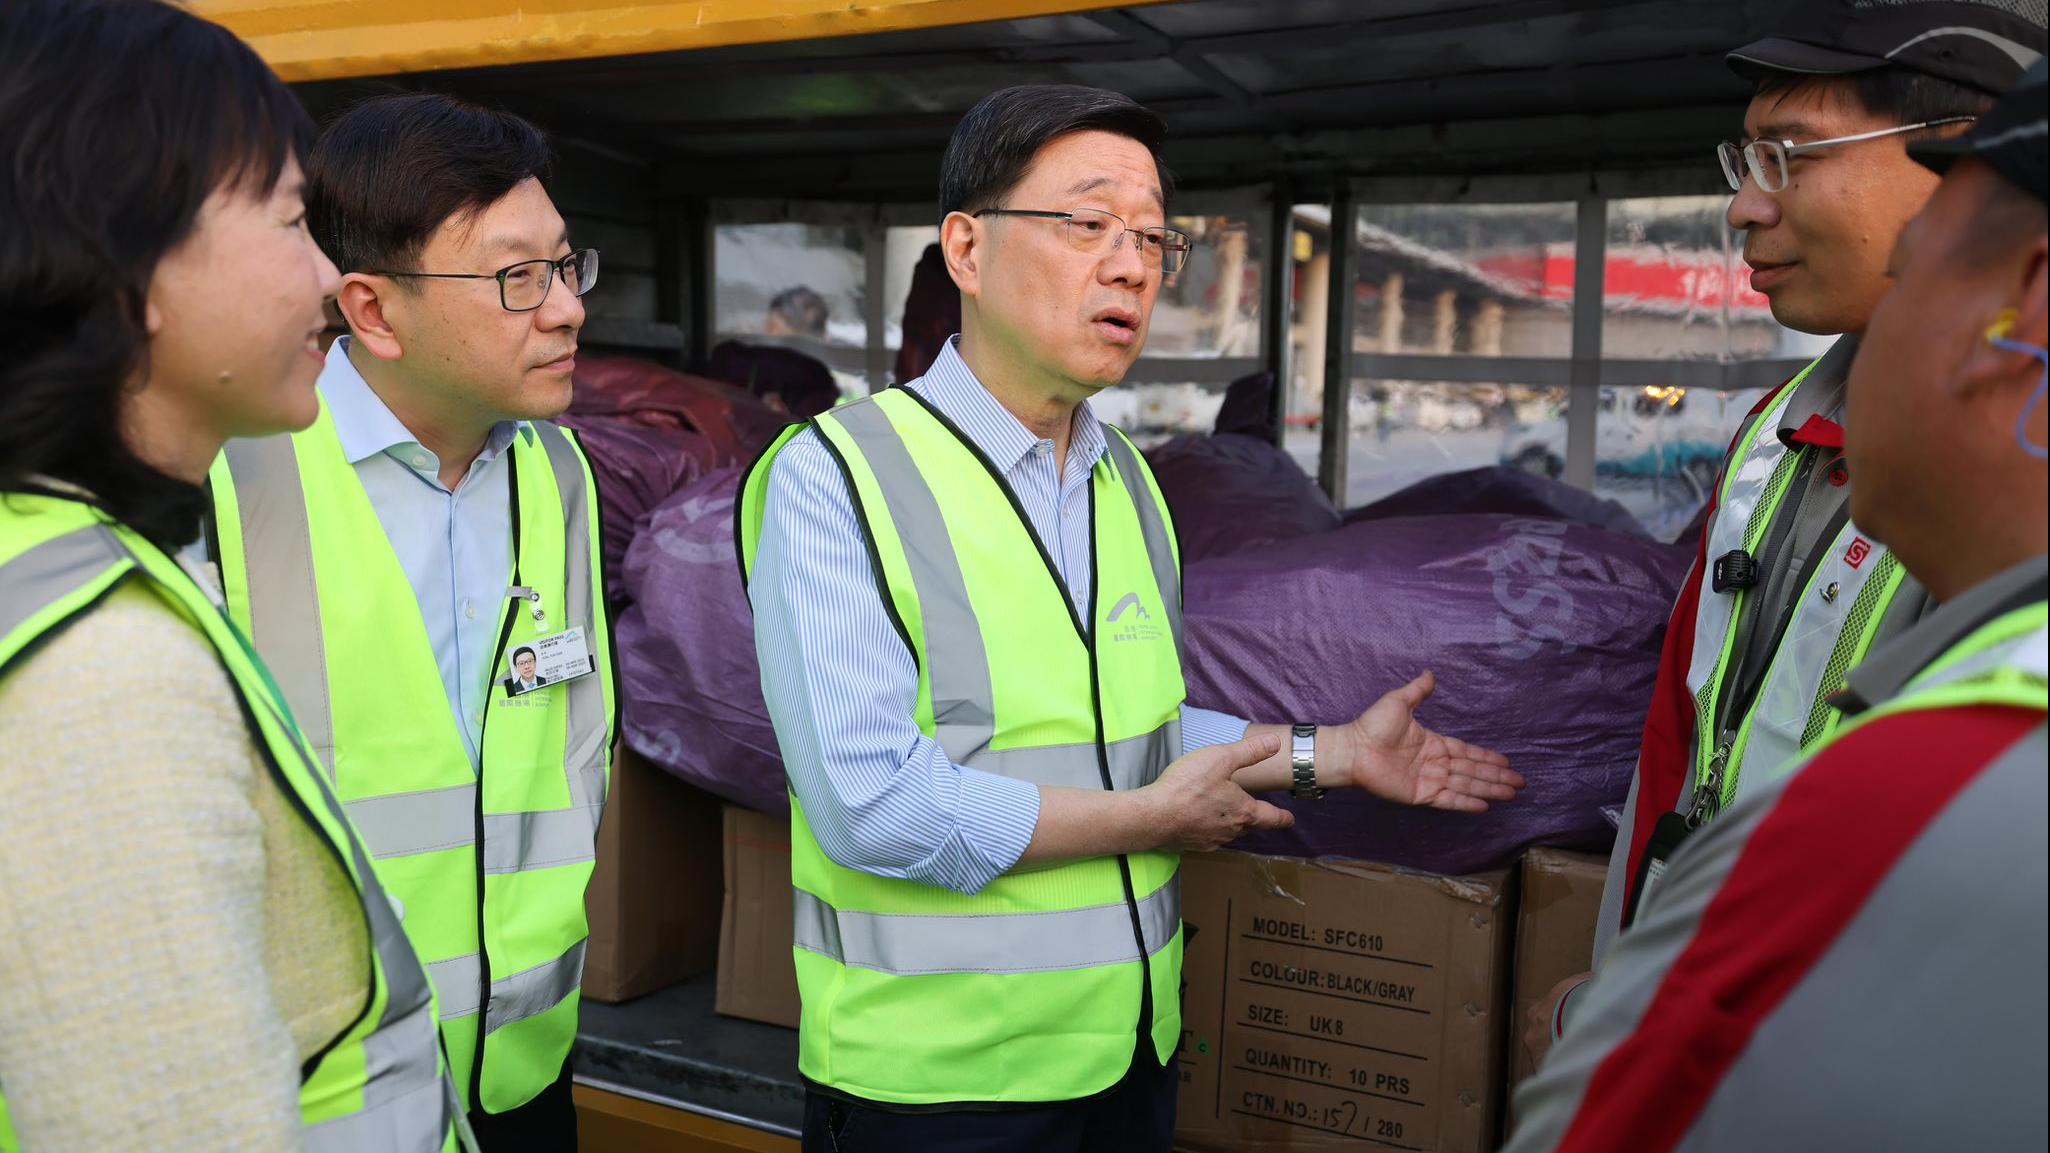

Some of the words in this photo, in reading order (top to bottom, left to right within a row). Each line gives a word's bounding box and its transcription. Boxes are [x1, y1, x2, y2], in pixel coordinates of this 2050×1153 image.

[1253, 917, 1316, 941] MODEL:
[1324, 928, 1383, 951] SFC610
[1247, 1005, 1288, 1026] SIZE:
[1245, 1049, 1331, 1077] QUANTITY:
[1350, 1068, 1367, 1086] 10
[1375, 1074, 1409, 1094] PRS
[1377, 1120, 1403, 1139] 280
